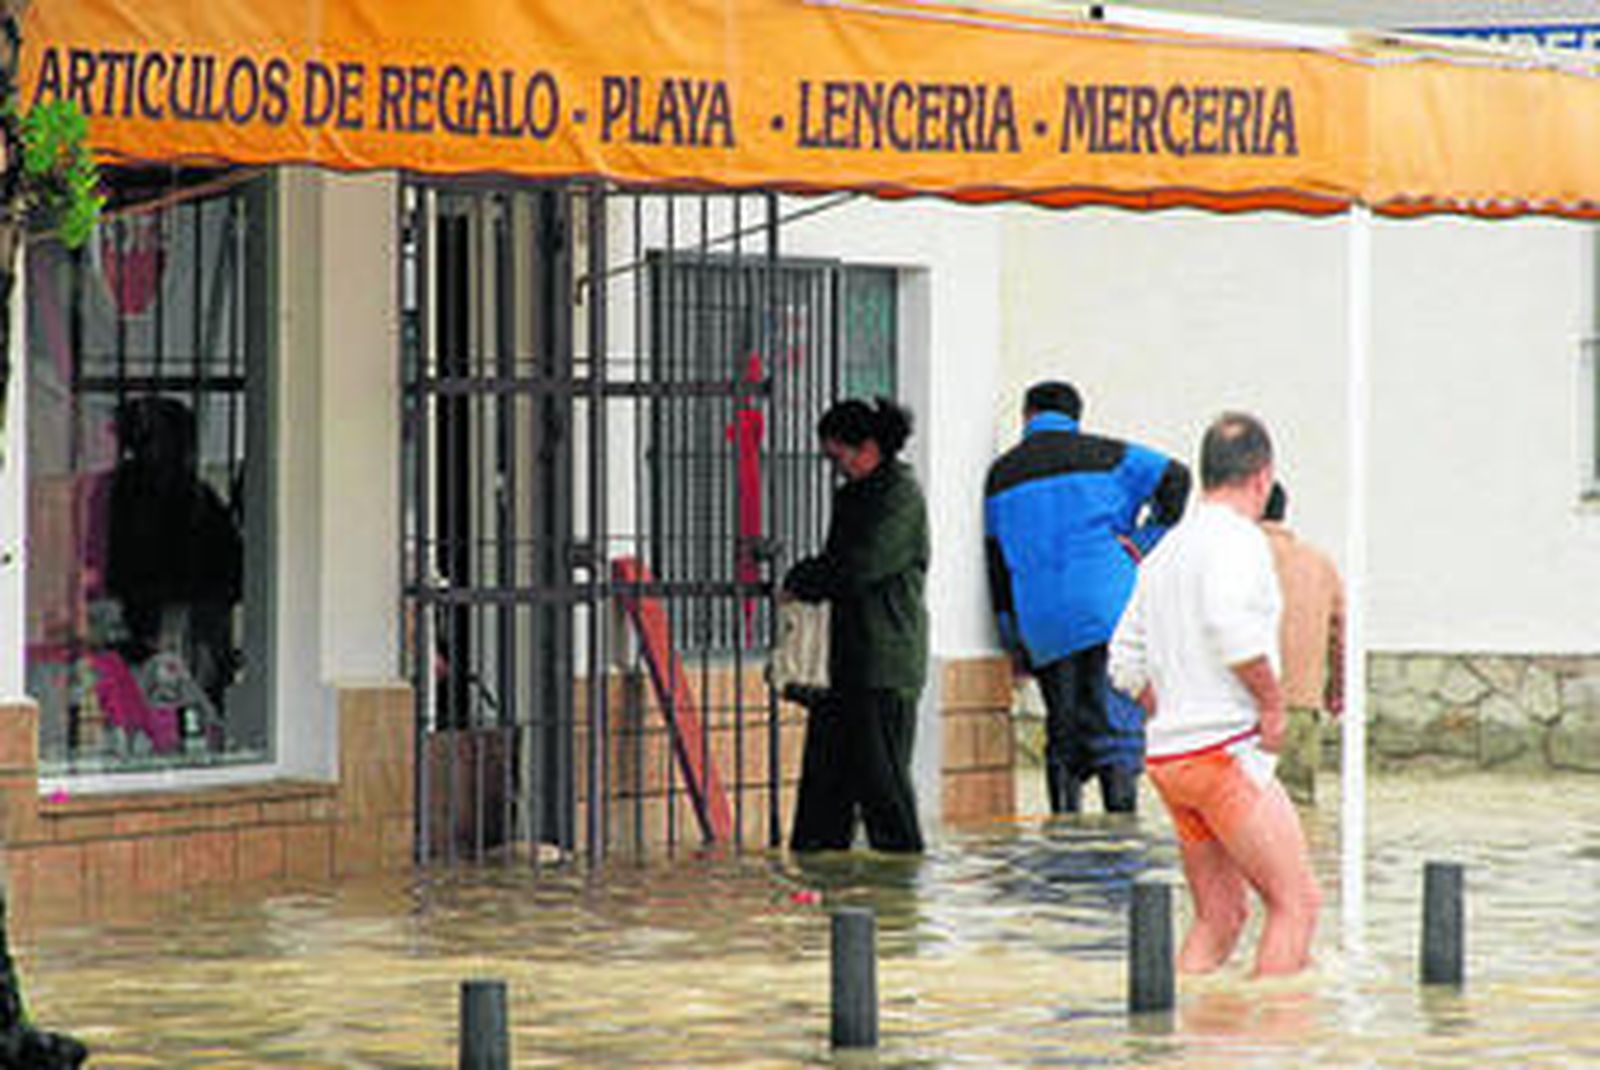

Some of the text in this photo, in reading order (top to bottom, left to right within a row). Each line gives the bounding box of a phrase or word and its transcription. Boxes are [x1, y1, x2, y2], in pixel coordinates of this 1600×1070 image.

[36, 47, 1298, 157] ARTICULOS DE REGALO PLAYA LENCERIA MERCERIA
